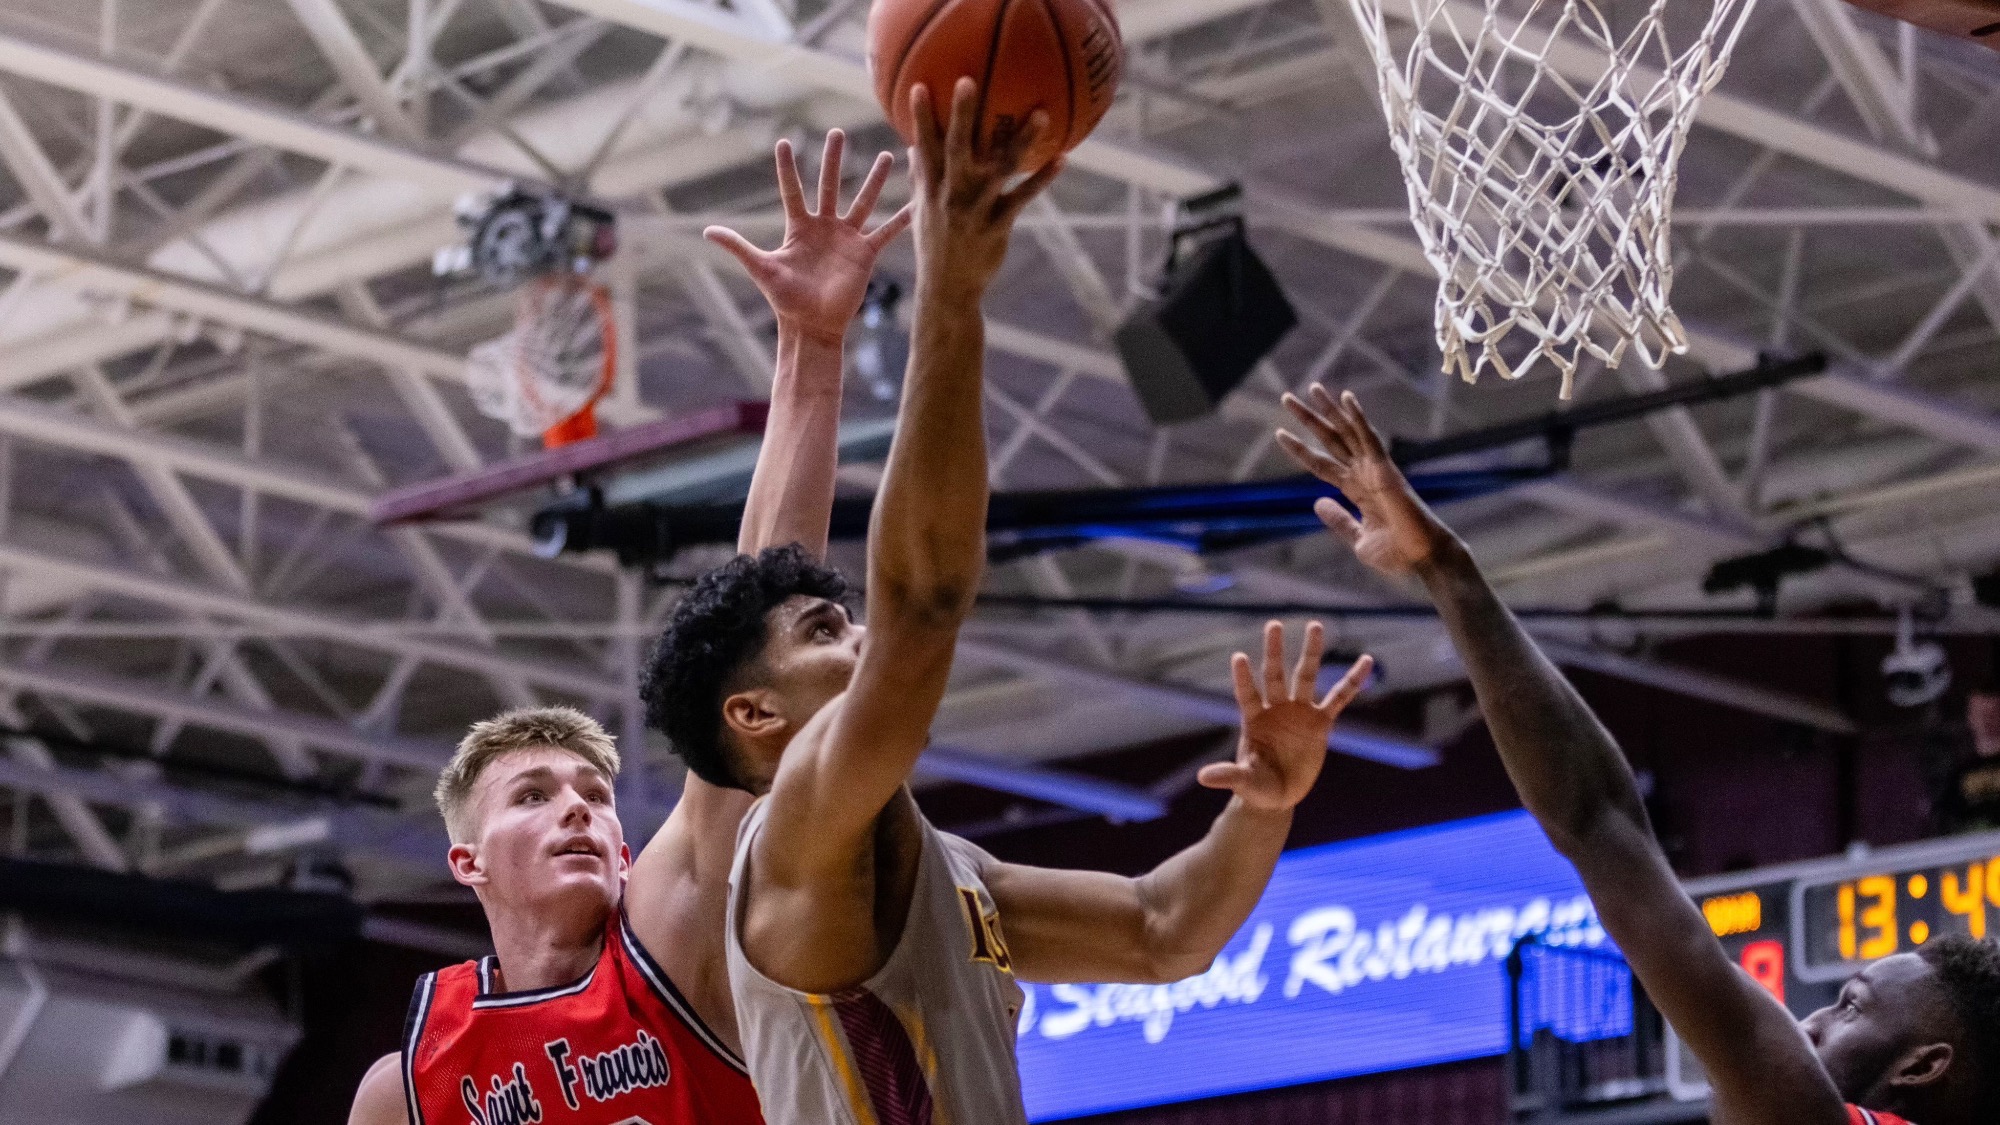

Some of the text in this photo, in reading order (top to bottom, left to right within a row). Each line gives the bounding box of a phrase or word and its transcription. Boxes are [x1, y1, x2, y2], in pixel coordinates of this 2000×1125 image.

[1284, 894, 1605, 999] Restauran
[1836, 856, 2000, 960] 13:4
[460, 1030, 670, 1125] Saint Francis
